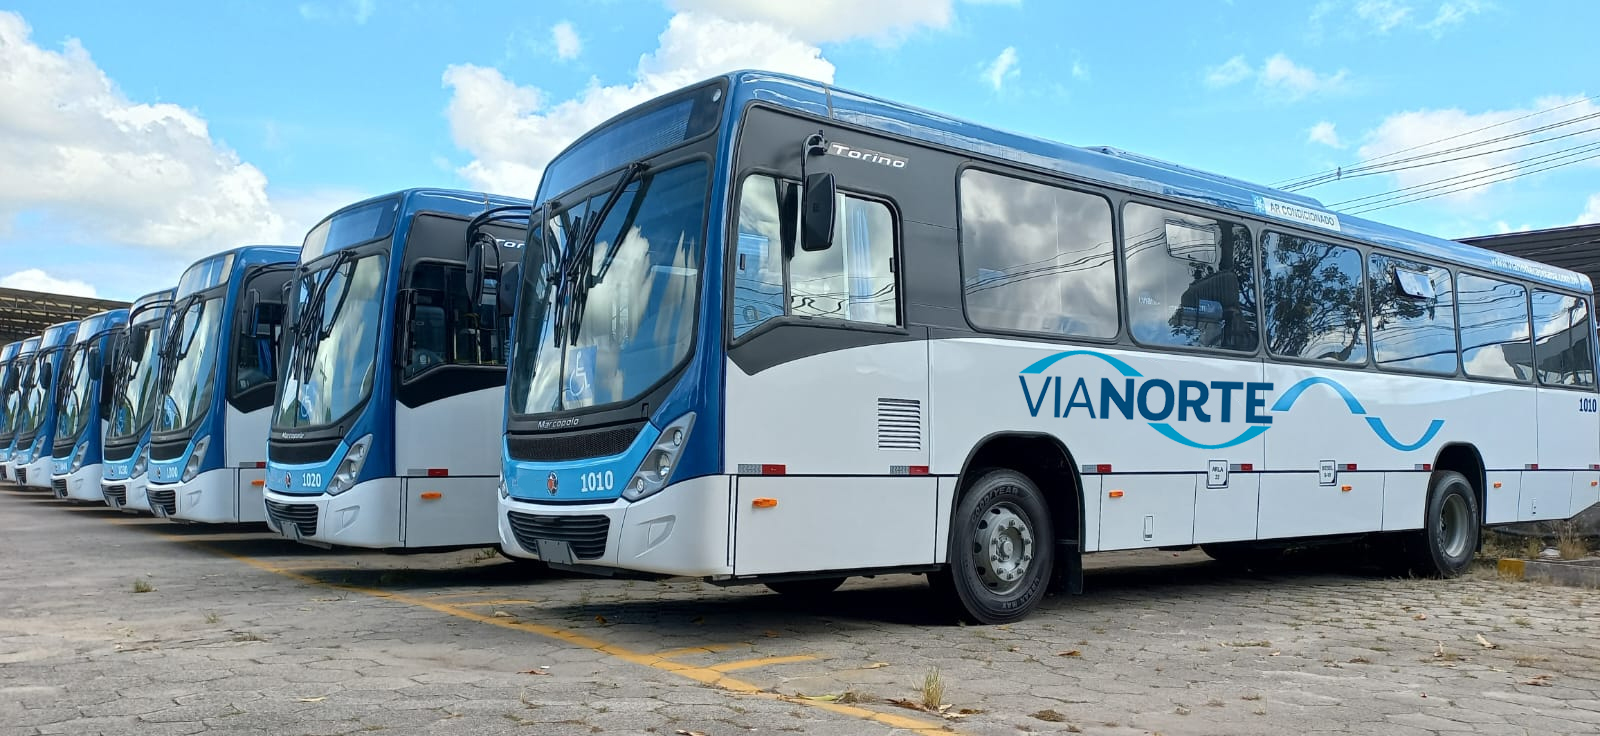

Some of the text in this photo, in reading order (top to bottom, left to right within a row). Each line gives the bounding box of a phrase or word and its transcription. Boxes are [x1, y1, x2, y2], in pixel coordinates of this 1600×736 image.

[832, 144, 905, 168] Torino
[1018, 375, 1274, 424] VIANORTE
[1579, 397, 1597, 413] 1010
[537, 417, 580, 430] Marcopolo
[302, 472, 322, 487] 1020
[580, 470, 614, 493] 1010
